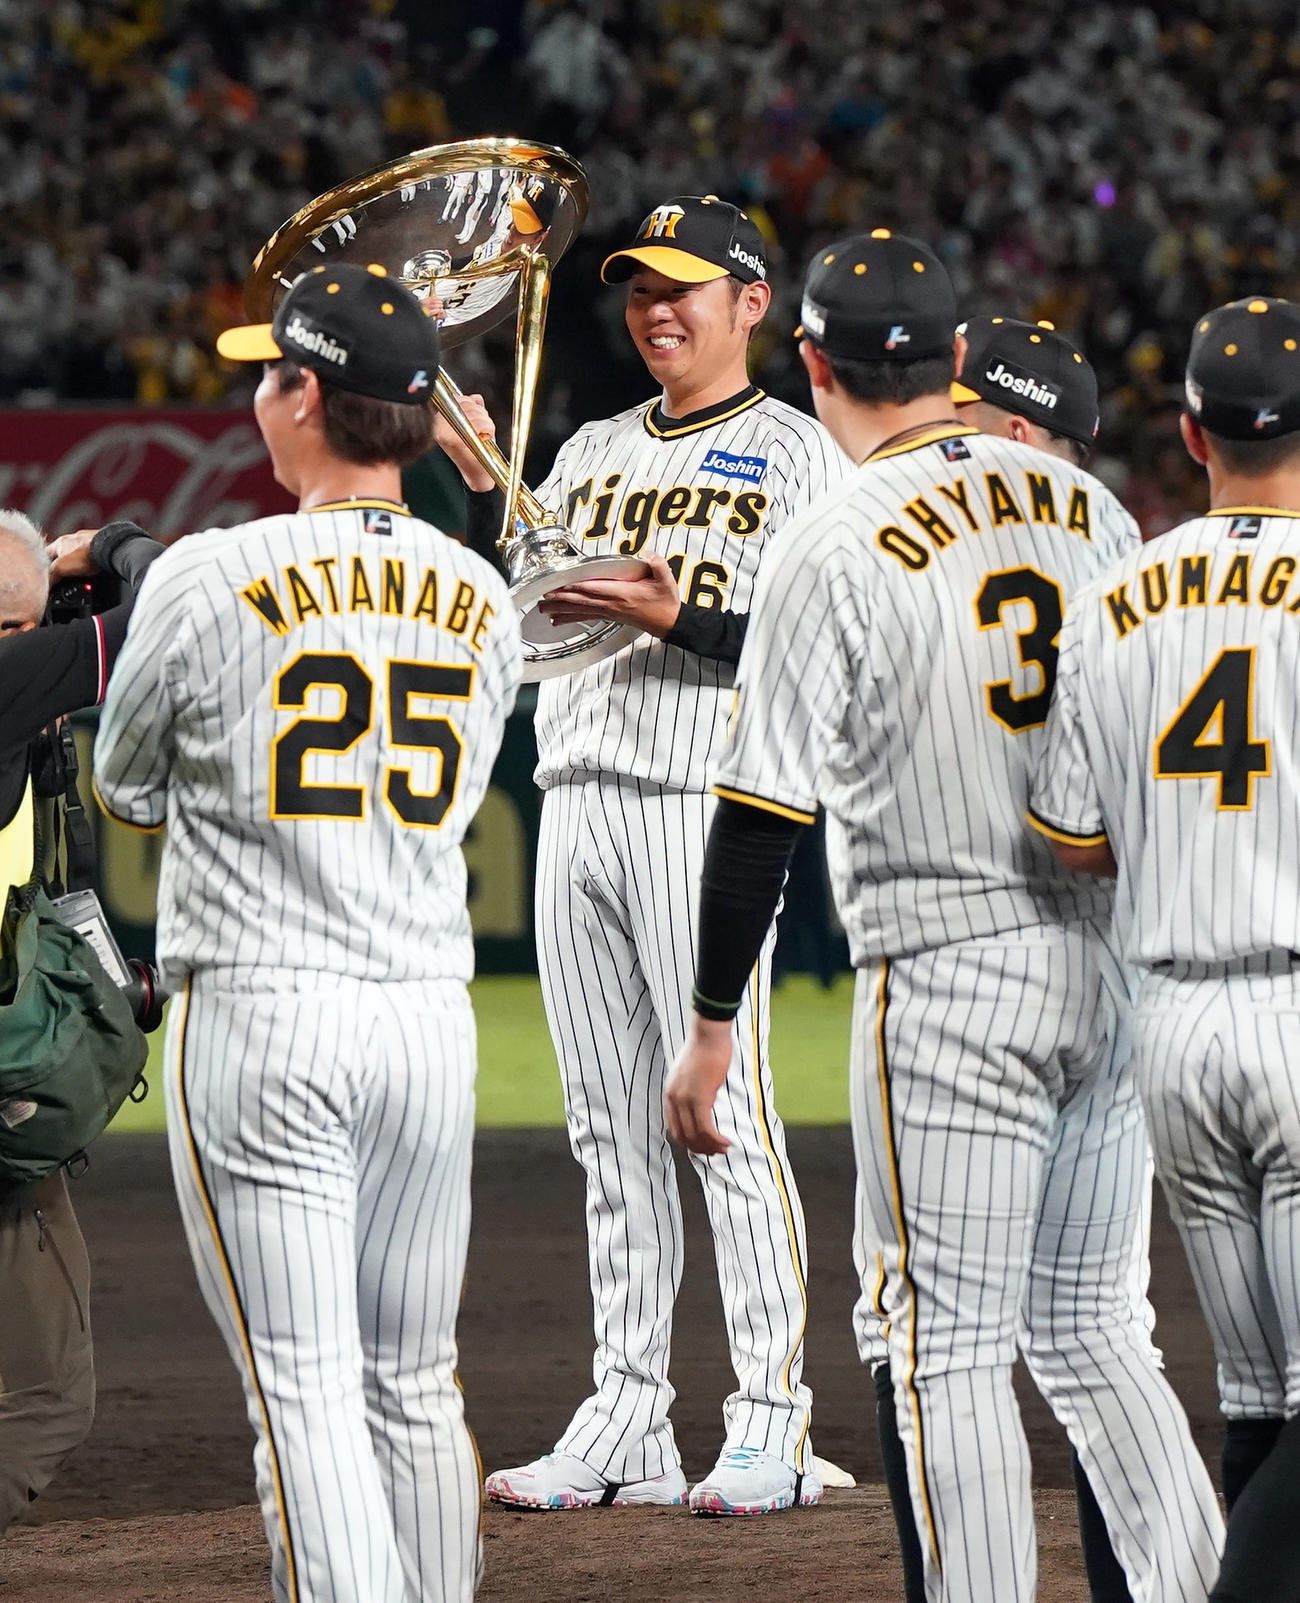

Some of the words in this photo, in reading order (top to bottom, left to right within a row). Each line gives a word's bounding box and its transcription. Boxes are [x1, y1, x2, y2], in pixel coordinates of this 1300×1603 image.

[285, 307, 349, 366] Joshin
[986, 364, 1057, 409] Joshin
[566, 473, 768, 556] Tigers
[703, 453, 763, 478] Joshin
[877, 471, 1093, 572] OHYAMA
[239, 555, 495, 653] WATANABE
[974, 565, 1063, 734] 3
[270, 652, 477, 830] 25
[1153, 646, 1271, 812] 4
